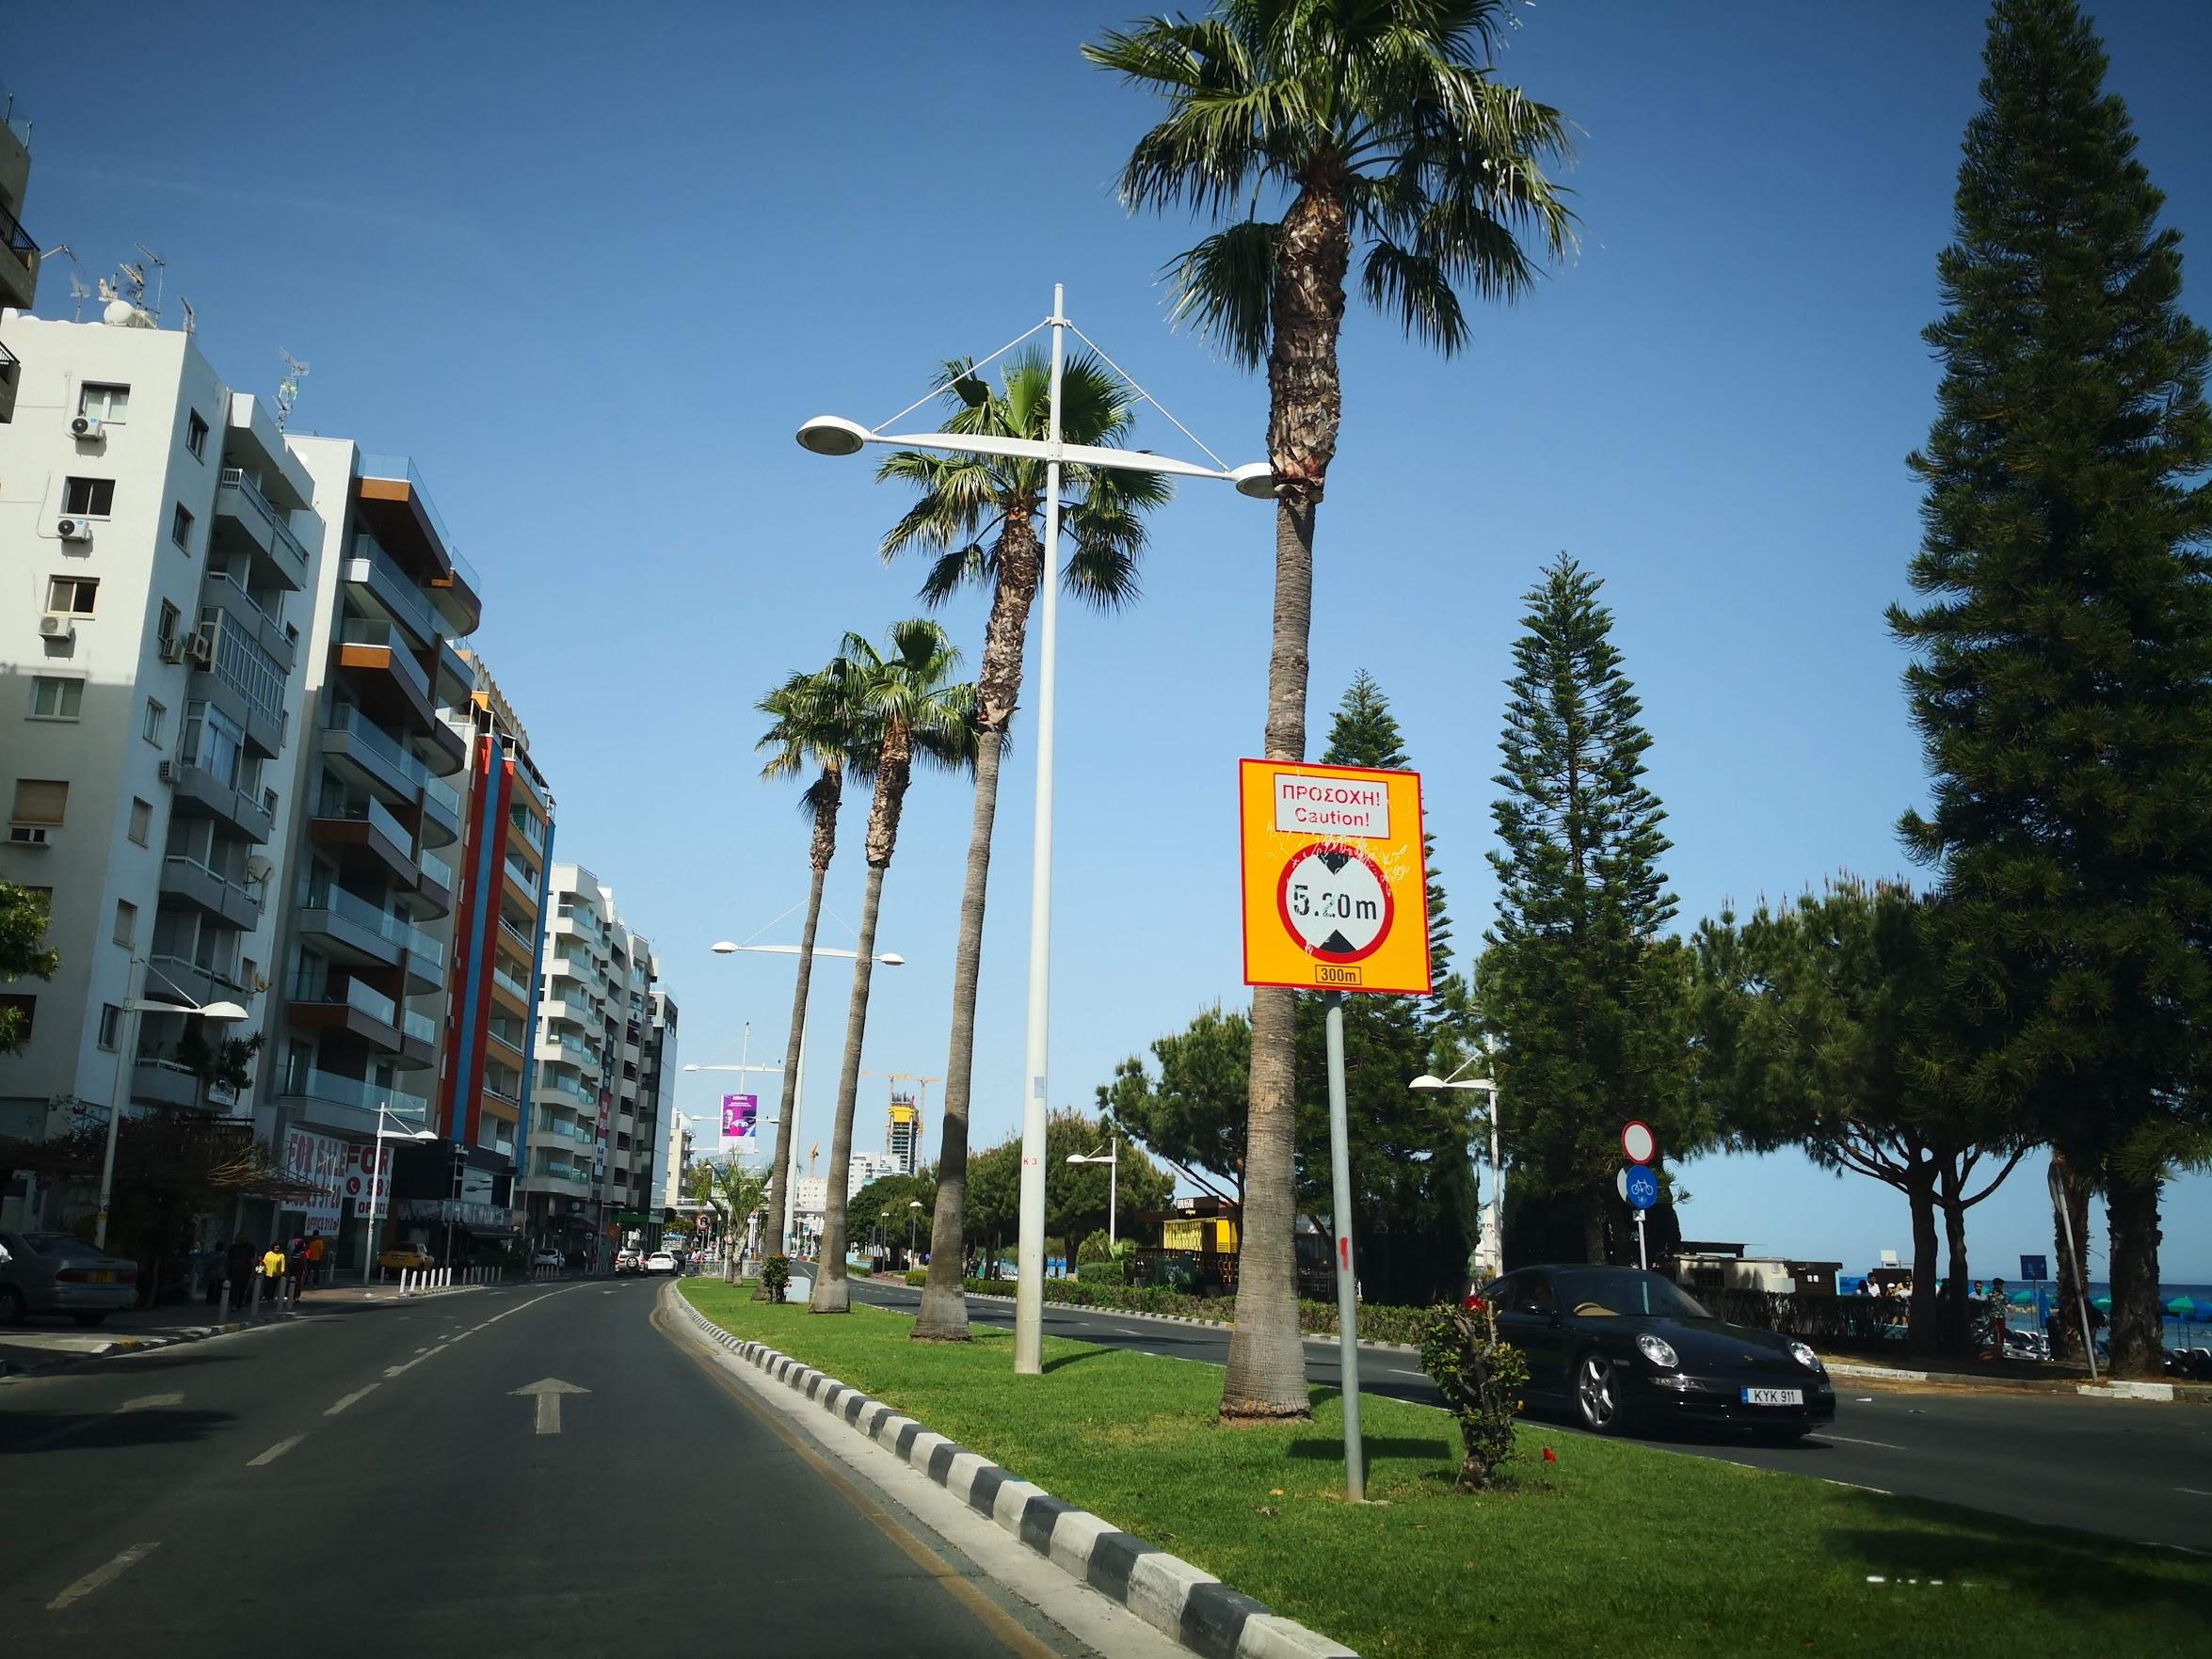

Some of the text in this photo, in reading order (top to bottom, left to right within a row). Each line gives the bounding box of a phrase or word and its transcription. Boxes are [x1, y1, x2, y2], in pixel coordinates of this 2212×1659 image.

[1282, 784, 1381, 806] ΠΡΟΣΟΧΗ!
[1294, 806, 1370, 827] Caution!
[1320, 967, 1356, 982] 300m
[288, 1133, 346, 1177] FOR SALE
[346, 1144, 389, 1175] FOR
[1754, 1389, 1795, 1403] KYK 911
